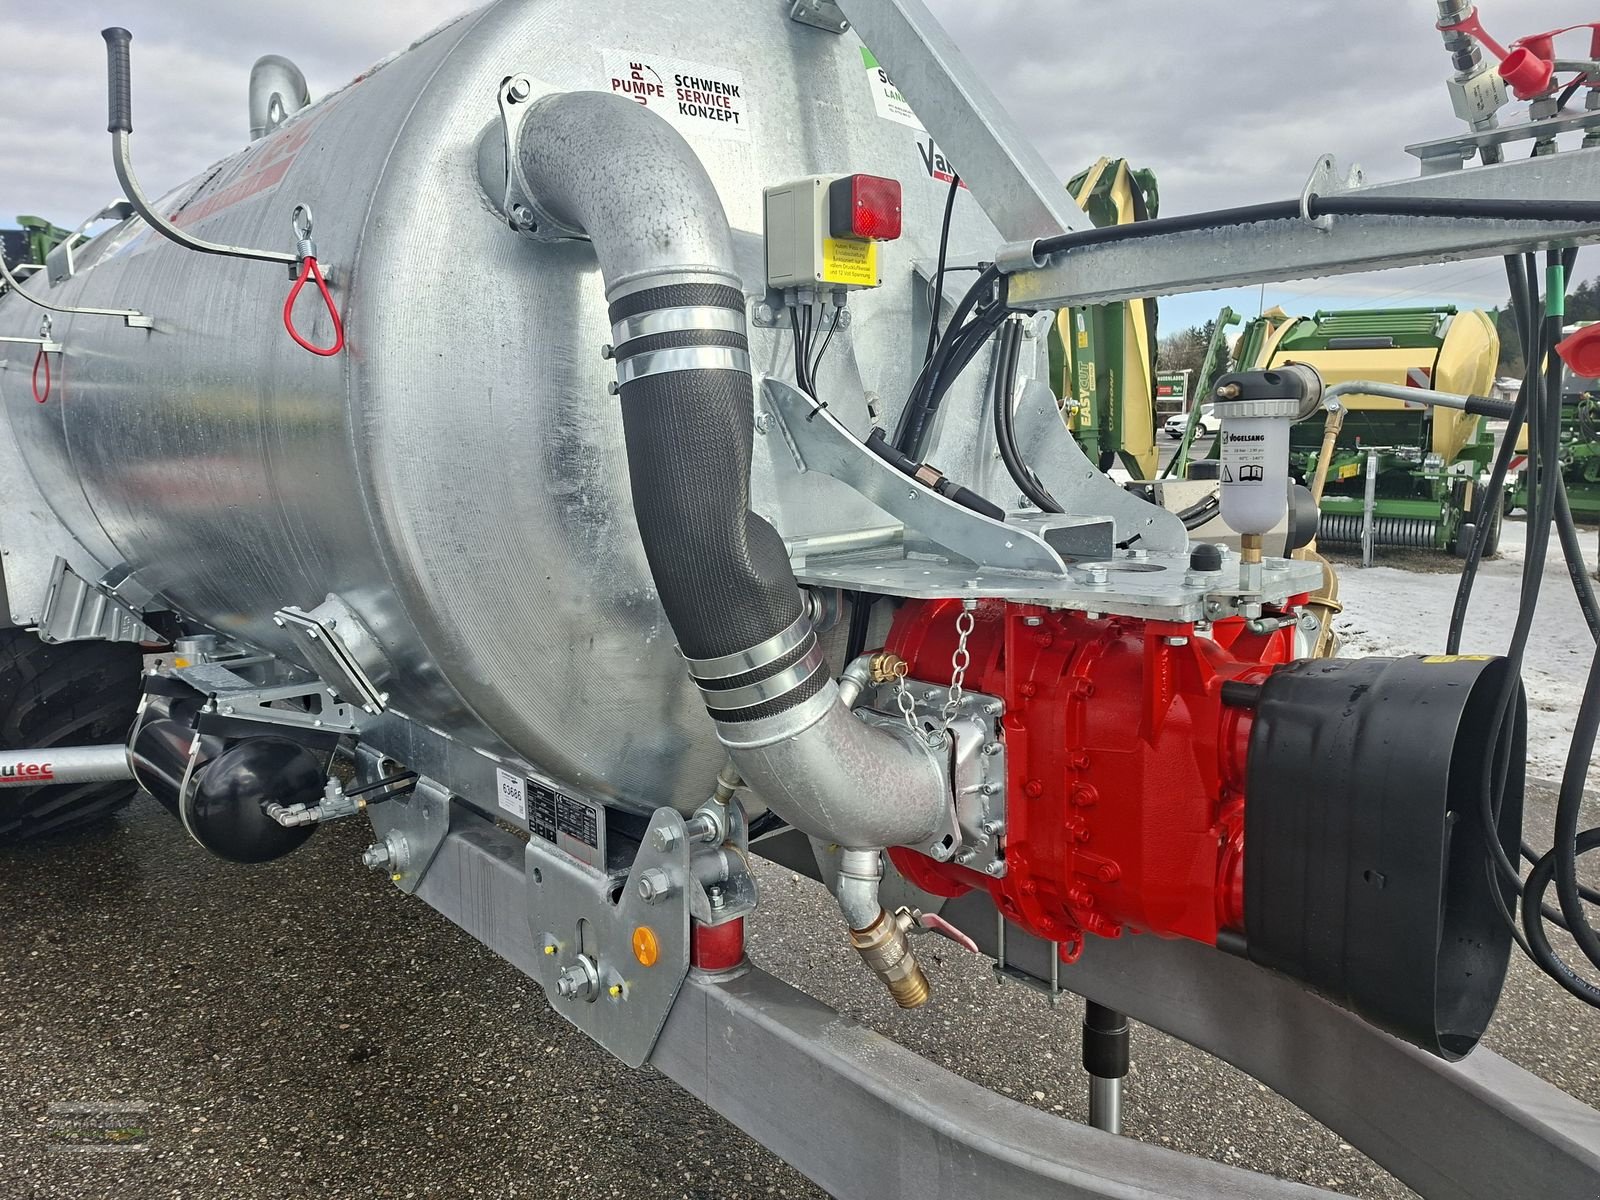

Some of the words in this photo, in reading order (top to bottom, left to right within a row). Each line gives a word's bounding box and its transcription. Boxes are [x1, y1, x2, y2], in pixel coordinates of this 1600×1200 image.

[611, 78, 665, 98] PUMPE
[674, 74, 741, 98] SCHWENK
[677, 88, 731, 109] SERVICE
[678, 102, 740, 124] KONZEPT
[1078, 361, 1092, 427] EASYCUT
[1230, 433, 1265, 442] VOGELSANG
[0, 762, 53, 777] utec
